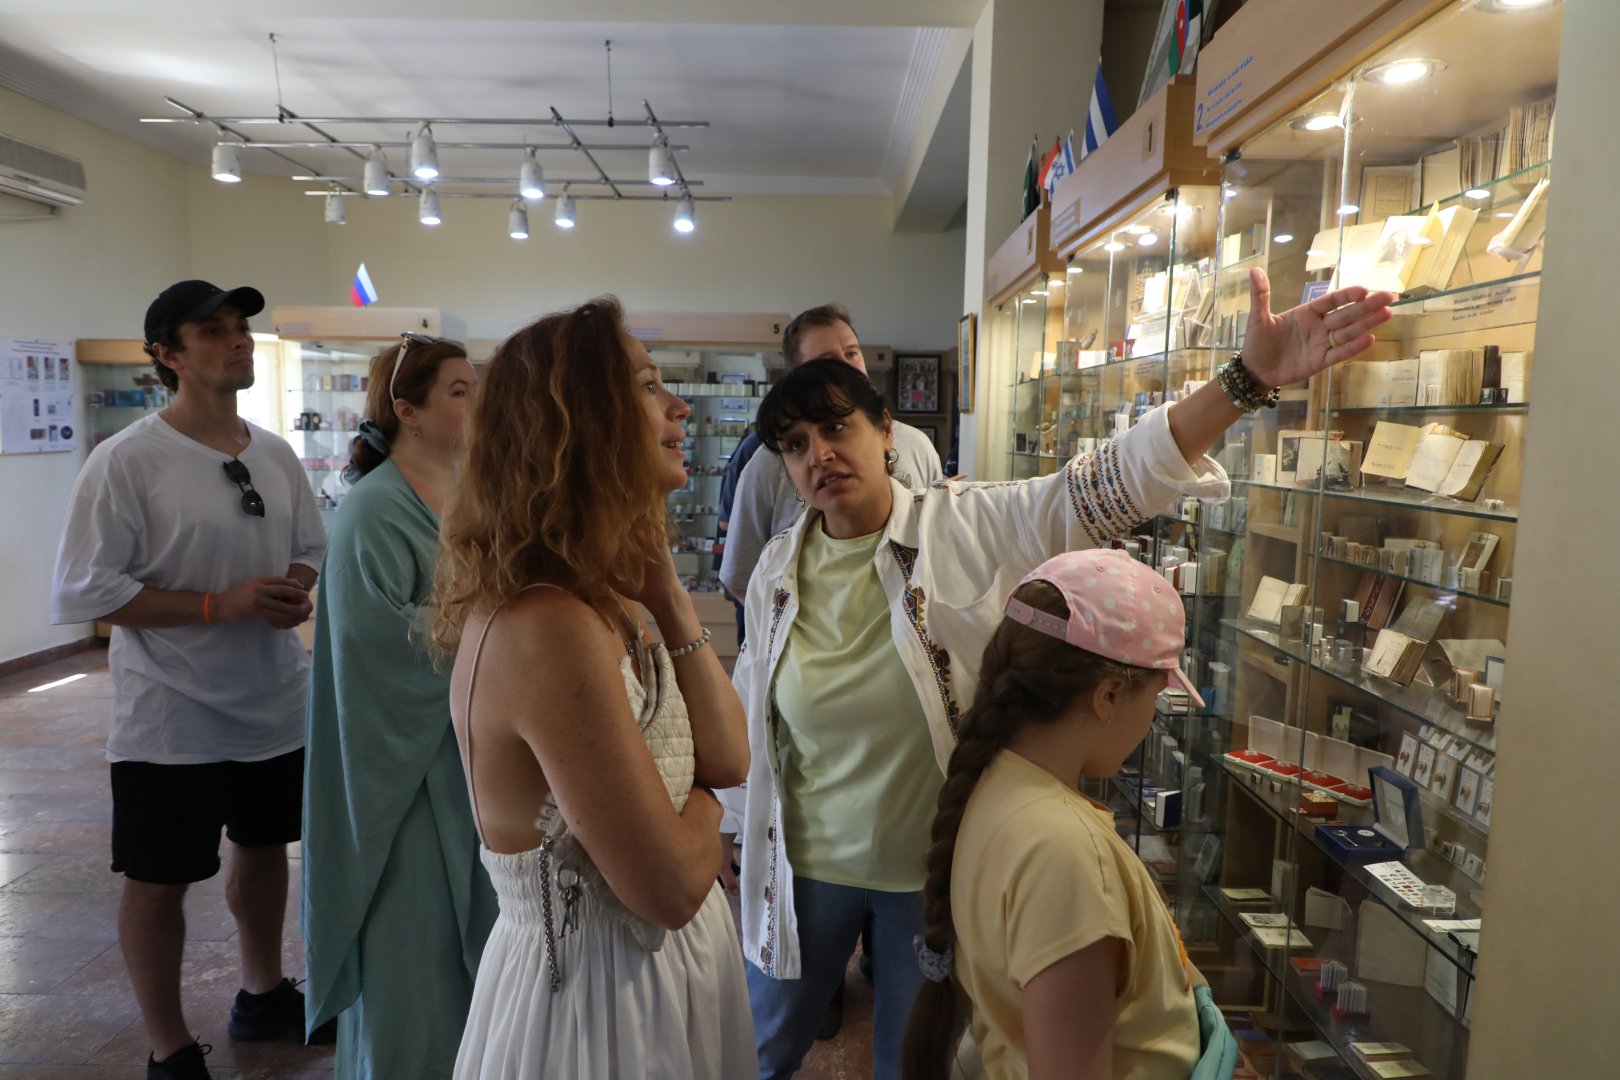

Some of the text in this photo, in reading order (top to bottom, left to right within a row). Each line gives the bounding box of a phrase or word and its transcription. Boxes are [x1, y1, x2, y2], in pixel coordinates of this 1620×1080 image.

[1196, 103, 1203, 132] 2
[1147, 121, 1153, 152] 1
[773, 324, 780, 334] 5
